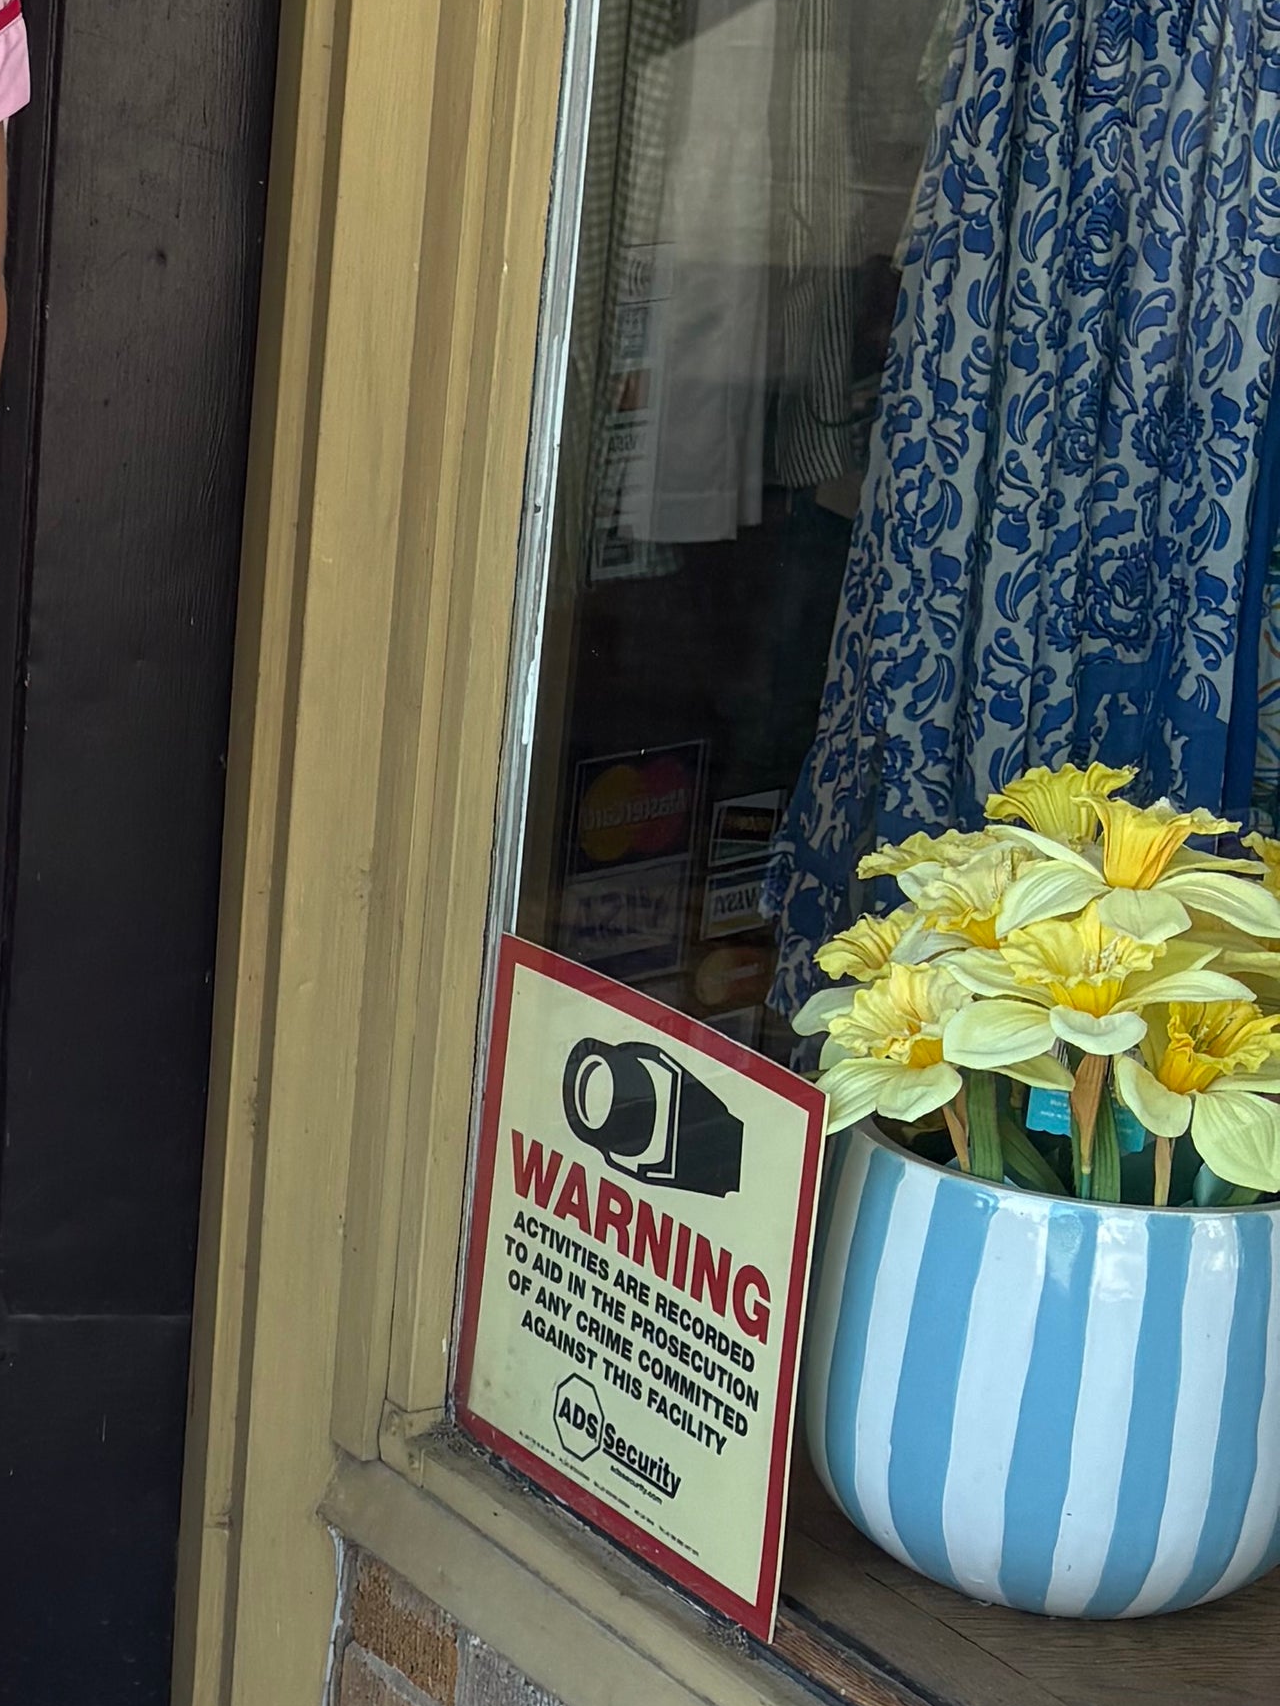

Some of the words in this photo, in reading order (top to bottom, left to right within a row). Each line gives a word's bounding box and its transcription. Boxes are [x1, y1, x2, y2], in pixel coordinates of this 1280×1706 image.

[511, 1128, 771, 1345] WARNING
[513, 1210, 610, 1281] ACTIVITIES
[613, 1268, 650, 1306] ARE
[654, 1292, 755, 1373] RECORDED
[504, 1234, 528, 1264] TO
[532, 1252, 563, 1284] AID
[567, 1271, 586, 1300] IN
[591, 1285, 627, 1325] THE
[630, 1310, 759, 1412] PROSECUTION
[508, 1269, 533, 1296] OF
[534, 1286, 573, 1322] ANY
[576, 1310, 633, 1362] CRIME
[638, 1349, 748, 1437] COMMITTED
[521, 1309, 598, 1371] AGAINST
[602, 1357, 643, 1401] THIS
[647, 1387, 728, 1456] FACILITY
[558, 1396, 599, 1440] ADS
[603, 1423, 682, 1493] Security
